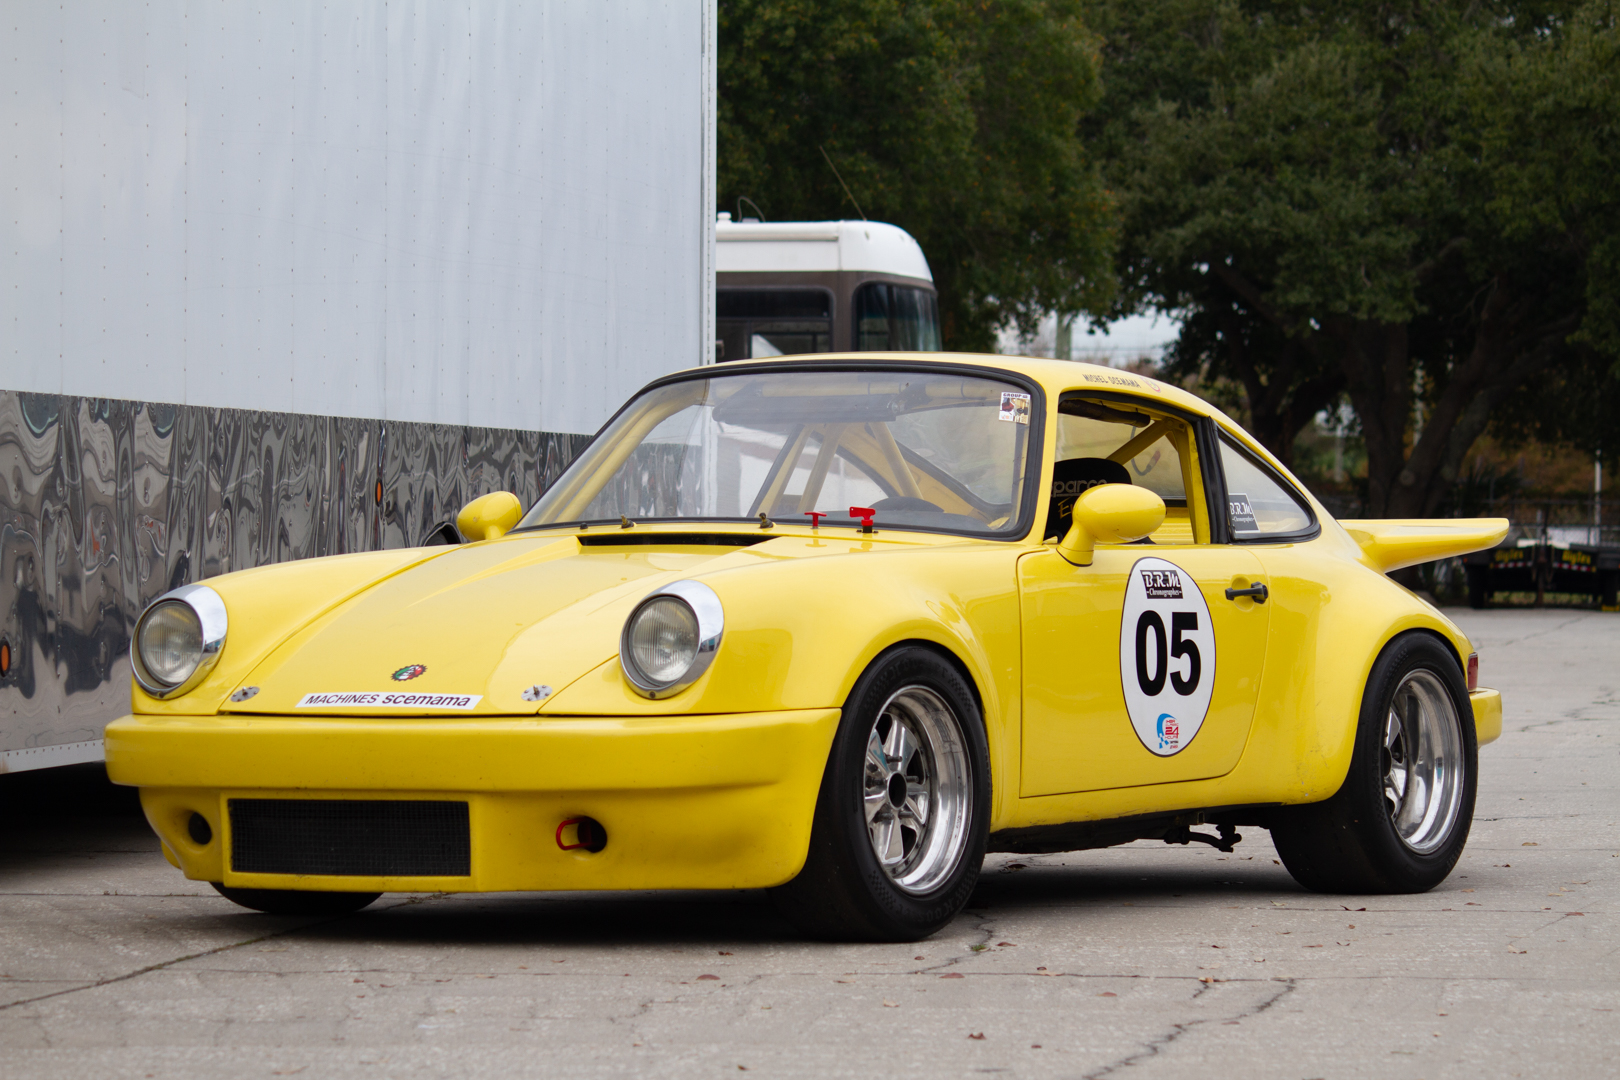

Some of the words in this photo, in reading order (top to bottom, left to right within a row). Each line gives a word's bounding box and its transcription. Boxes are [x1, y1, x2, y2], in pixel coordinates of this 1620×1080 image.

[1052, 479, 1107, 498] parc
[1135, 610, 1202, 697] 05
[305, 694, 379, 705] MACHINES
[382, 694, 471, 707] scemama
[1165, 726, 1180, 739] 24
